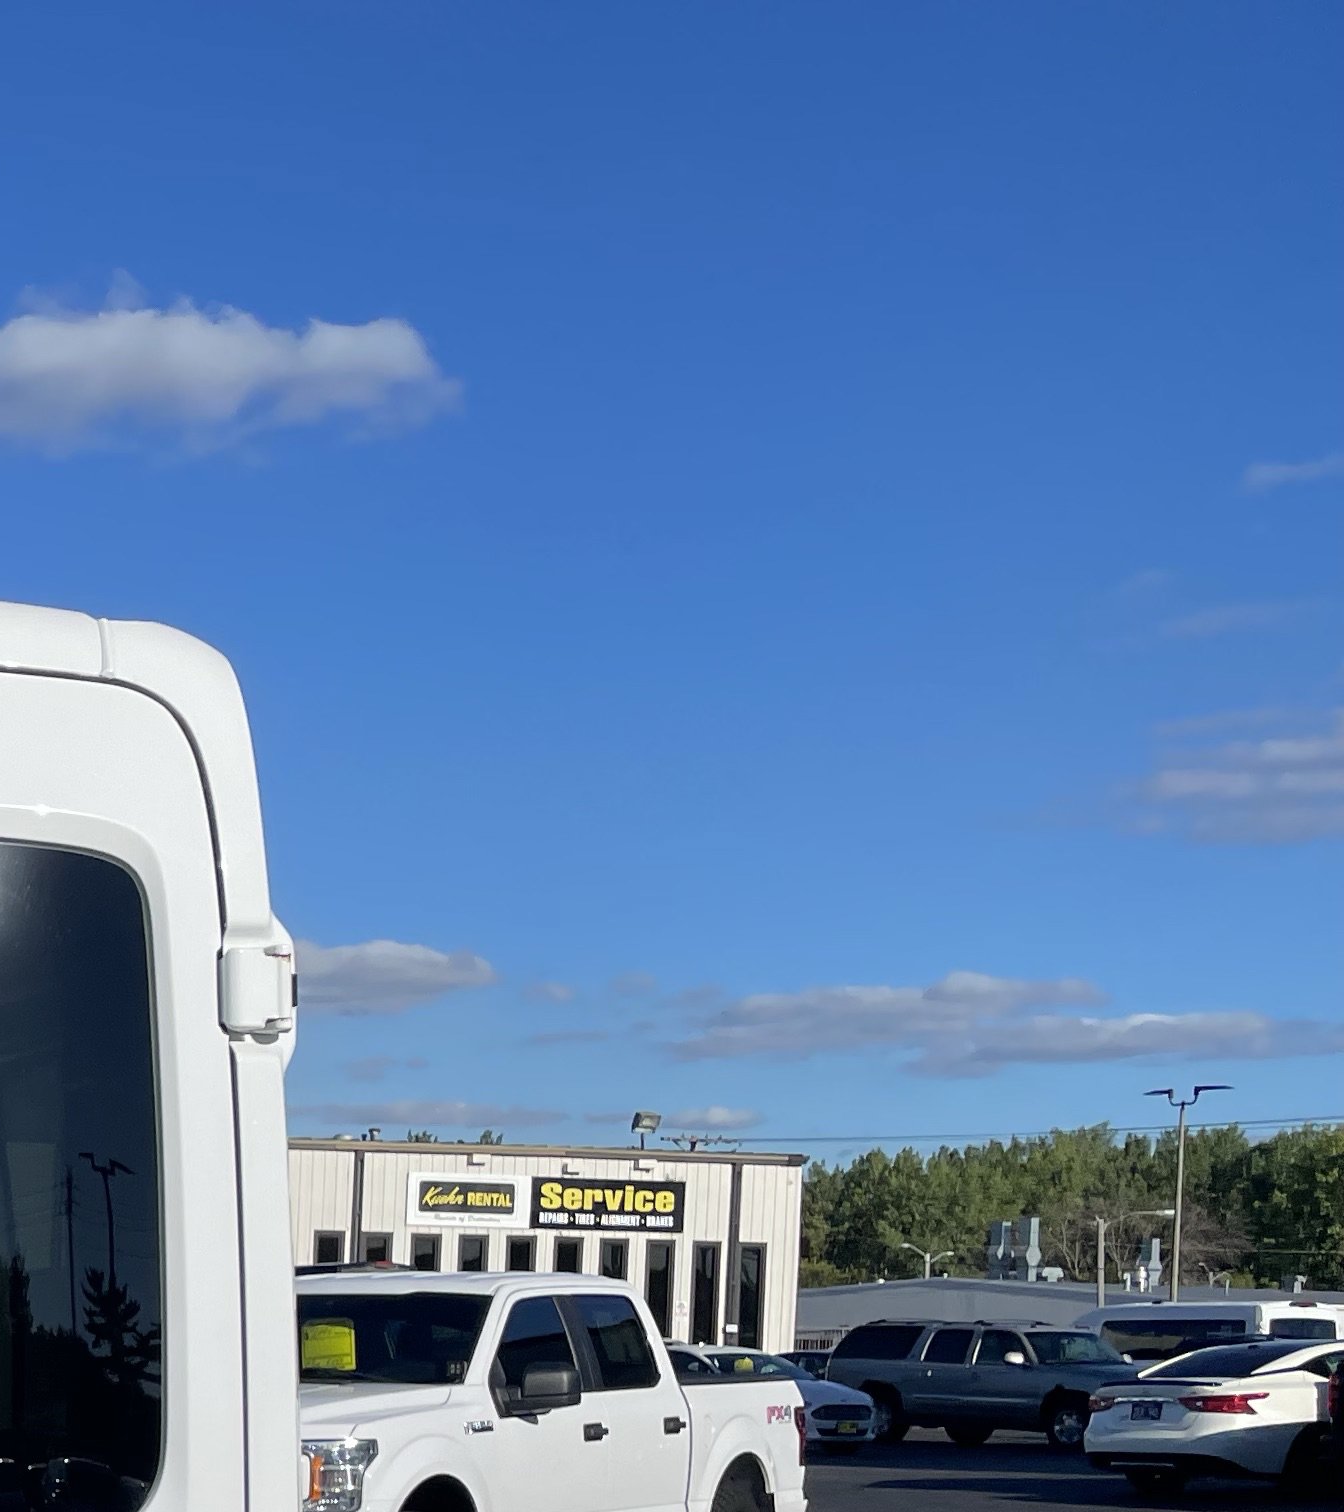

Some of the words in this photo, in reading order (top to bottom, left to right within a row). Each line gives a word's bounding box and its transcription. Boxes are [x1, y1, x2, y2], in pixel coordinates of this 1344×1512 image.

[421, 1185, 465, 1208] Kuehn
[466, 1192, 512, 1208] RENTAL
[540, 1181, 675, 1213] Service
[767, 1405, 792, 1424] FX4
